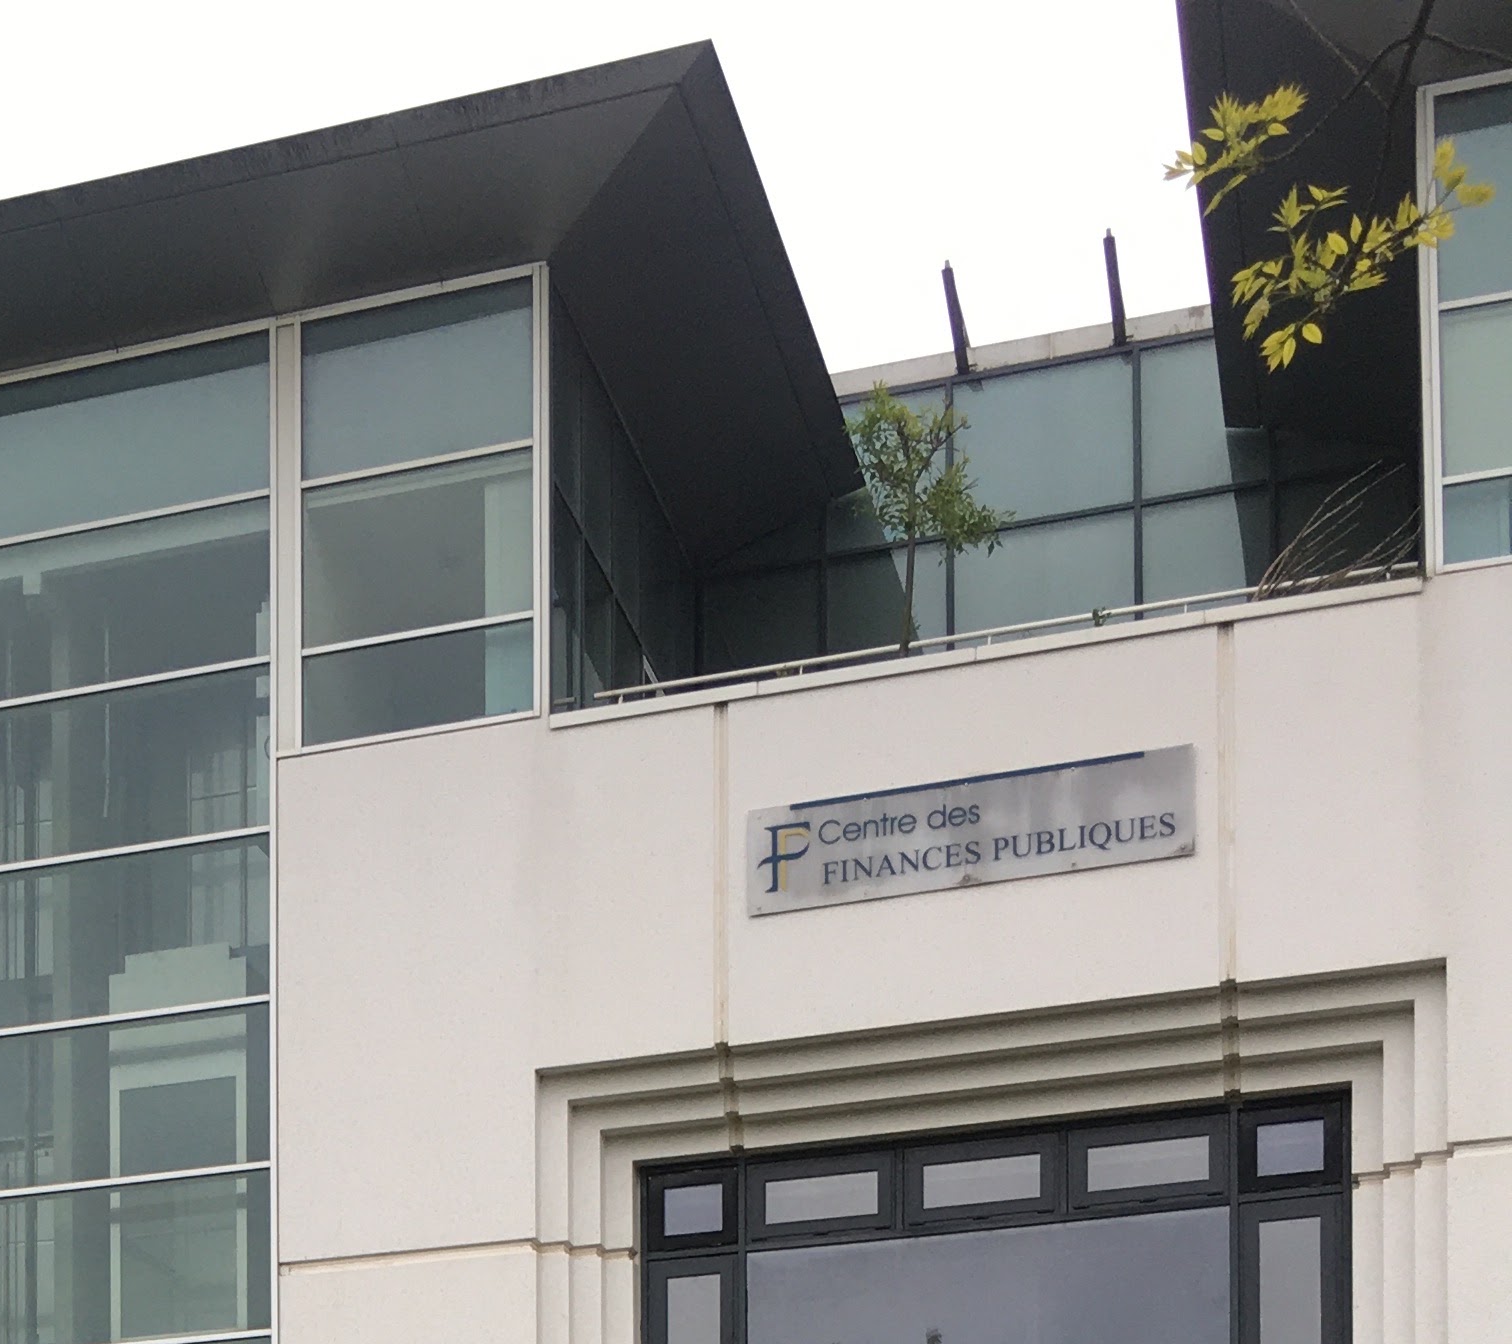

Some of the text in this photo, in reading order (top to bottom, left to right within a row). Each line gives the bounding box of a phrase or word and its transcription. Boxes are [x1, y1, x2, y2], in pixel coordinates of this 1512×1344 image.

[818, 803, 981, 846] Centre des
[822, 812, 1177, 886] FINANCES PUBLIQUES
